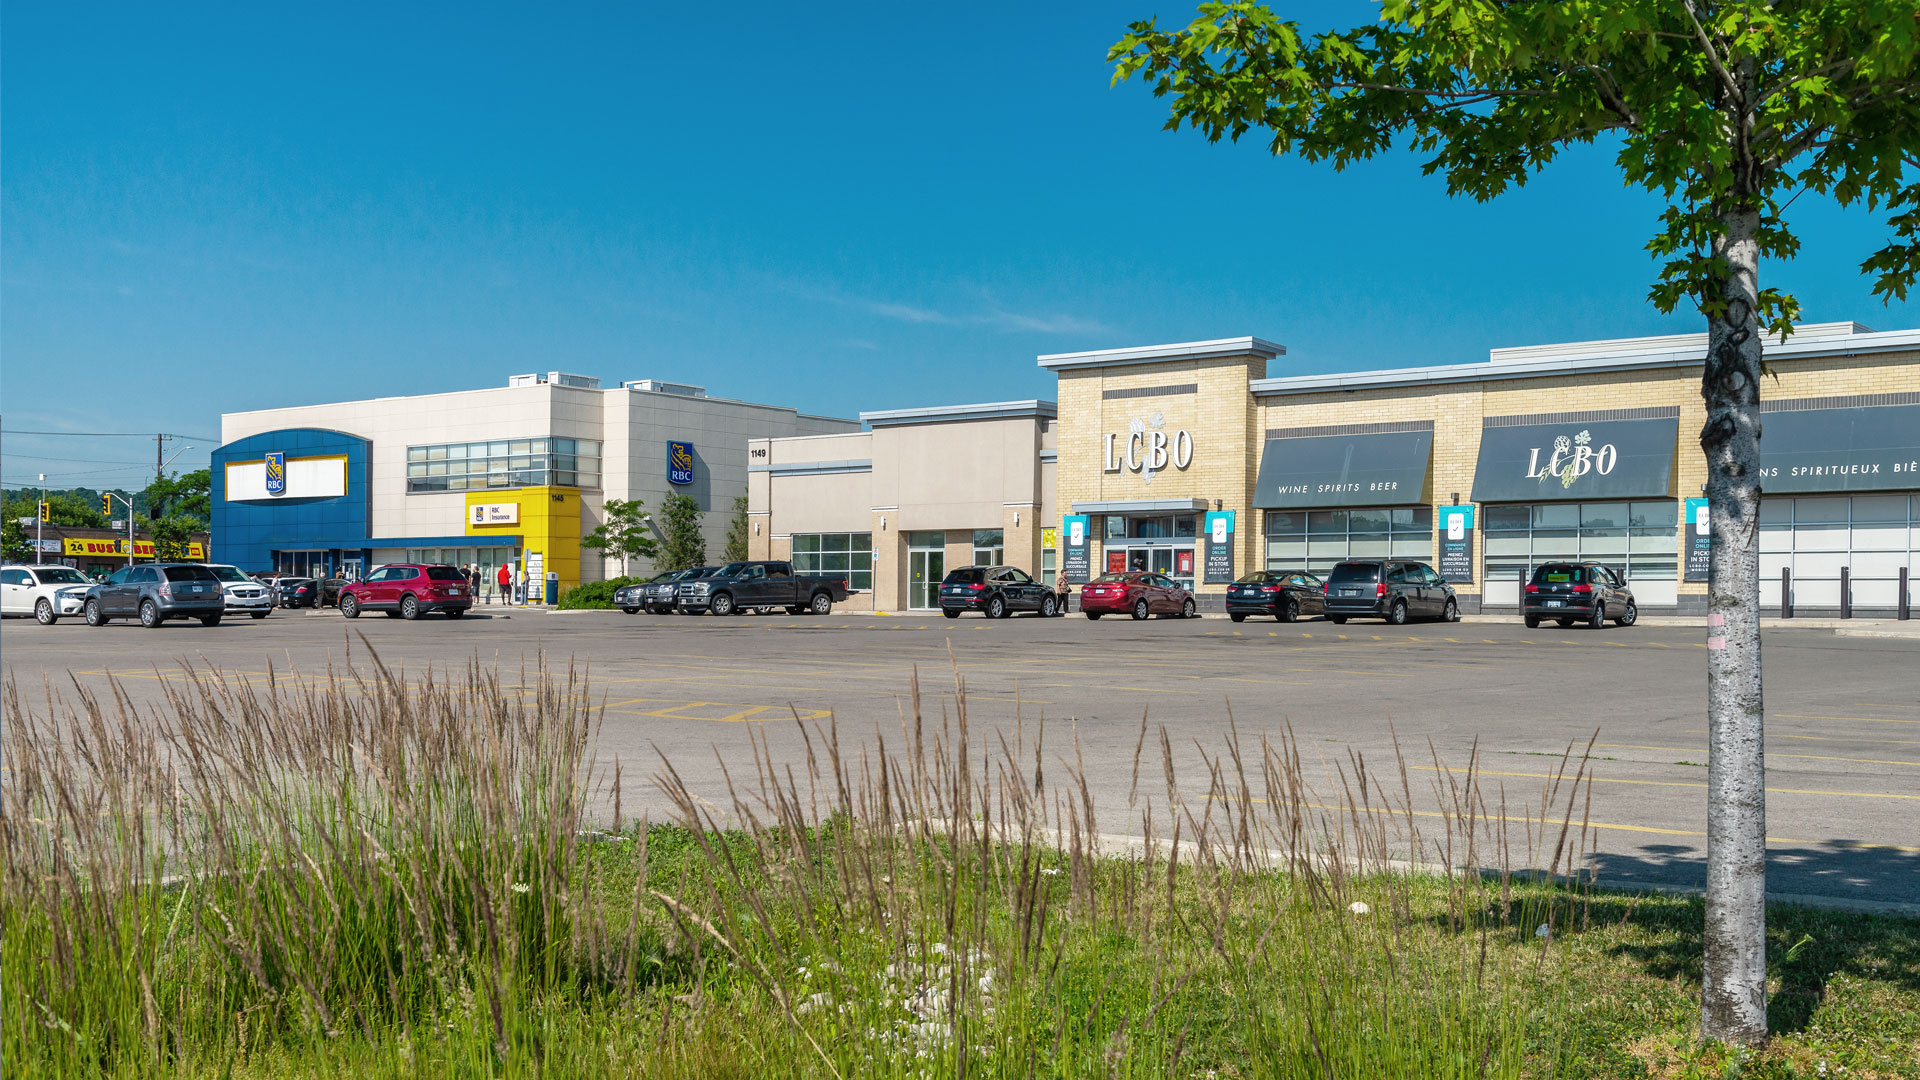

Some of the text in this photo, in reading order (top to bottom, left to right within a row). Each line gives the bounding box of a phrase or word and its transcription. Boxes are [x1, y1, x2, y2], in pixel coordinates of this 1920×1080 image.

[751, 449, 766, 458] 1149
[1104, 430, 1193, 473] LCBO
[1525, 444, 1617, 478] LCBO
[1759, 461, 1917, 477] NS SPIRITUEUX BIÈ
[672, 471, 691, 480] RBC
[268, 481, 281, 489] RBC
[1278, 482, 1398, 494] WINE SPIRITS BEER
[70, 543, 83, 551] 24
[87, 543, 116, 553] BUS
